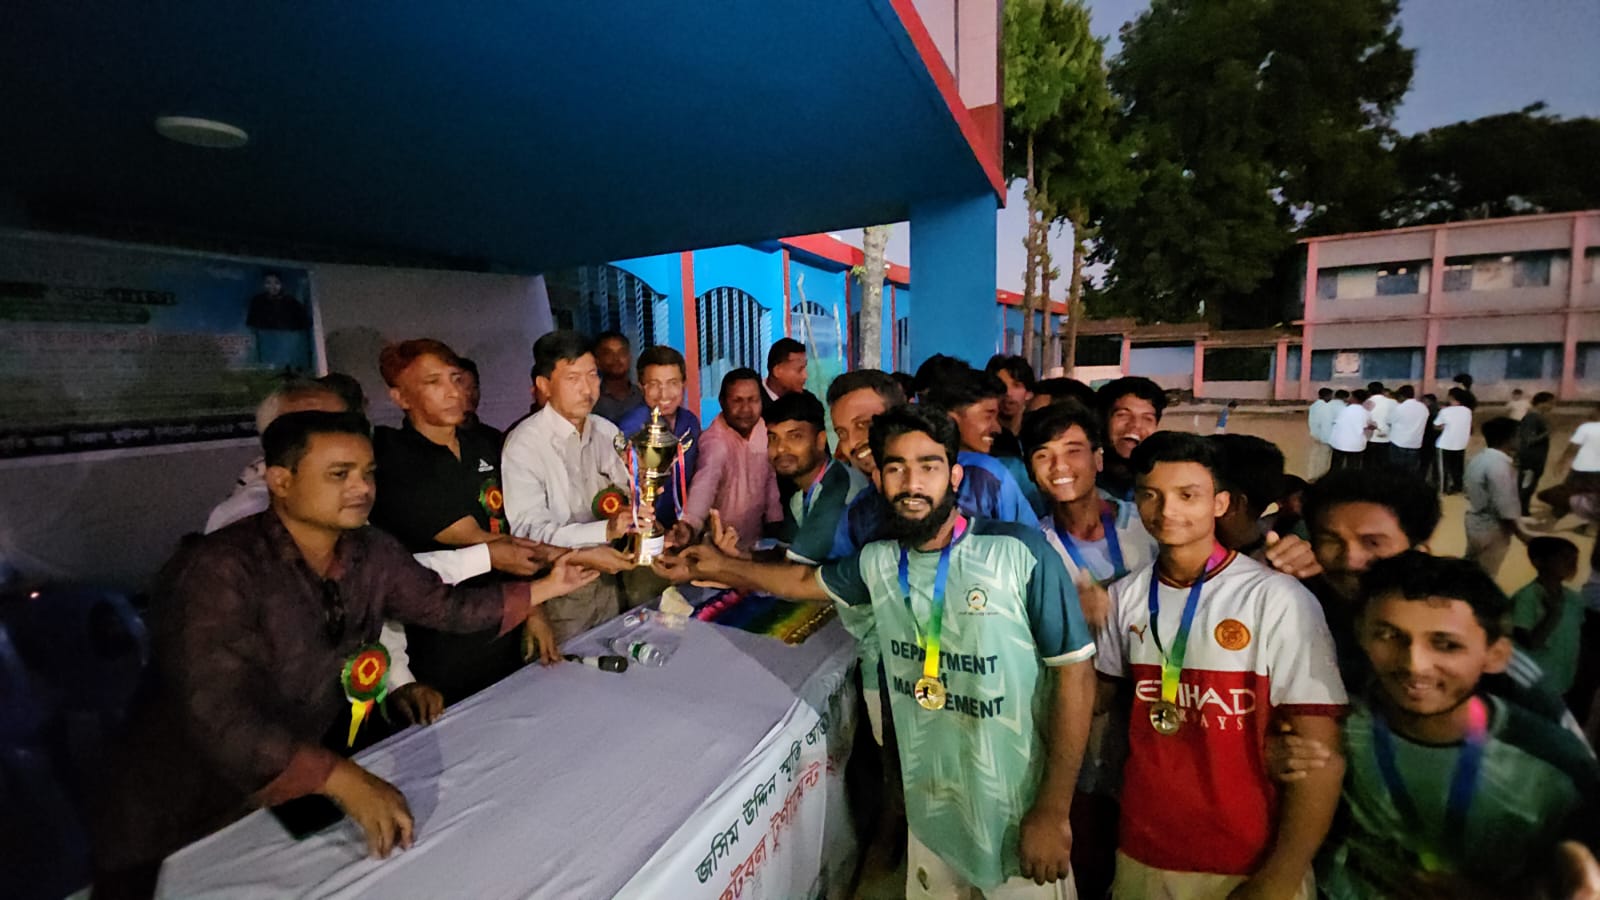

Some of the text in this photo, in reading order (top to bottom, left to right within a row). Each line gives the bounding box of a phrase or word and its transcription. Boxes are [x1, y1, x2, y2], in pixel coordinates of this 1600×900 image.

[891, 640, 998, 676] DEPTMENT
[893, 676, 1005, 719] MAEMENT
[1136, 680, 1256, 716] EIHAD
[694, 819, 739, 884] জসিম
